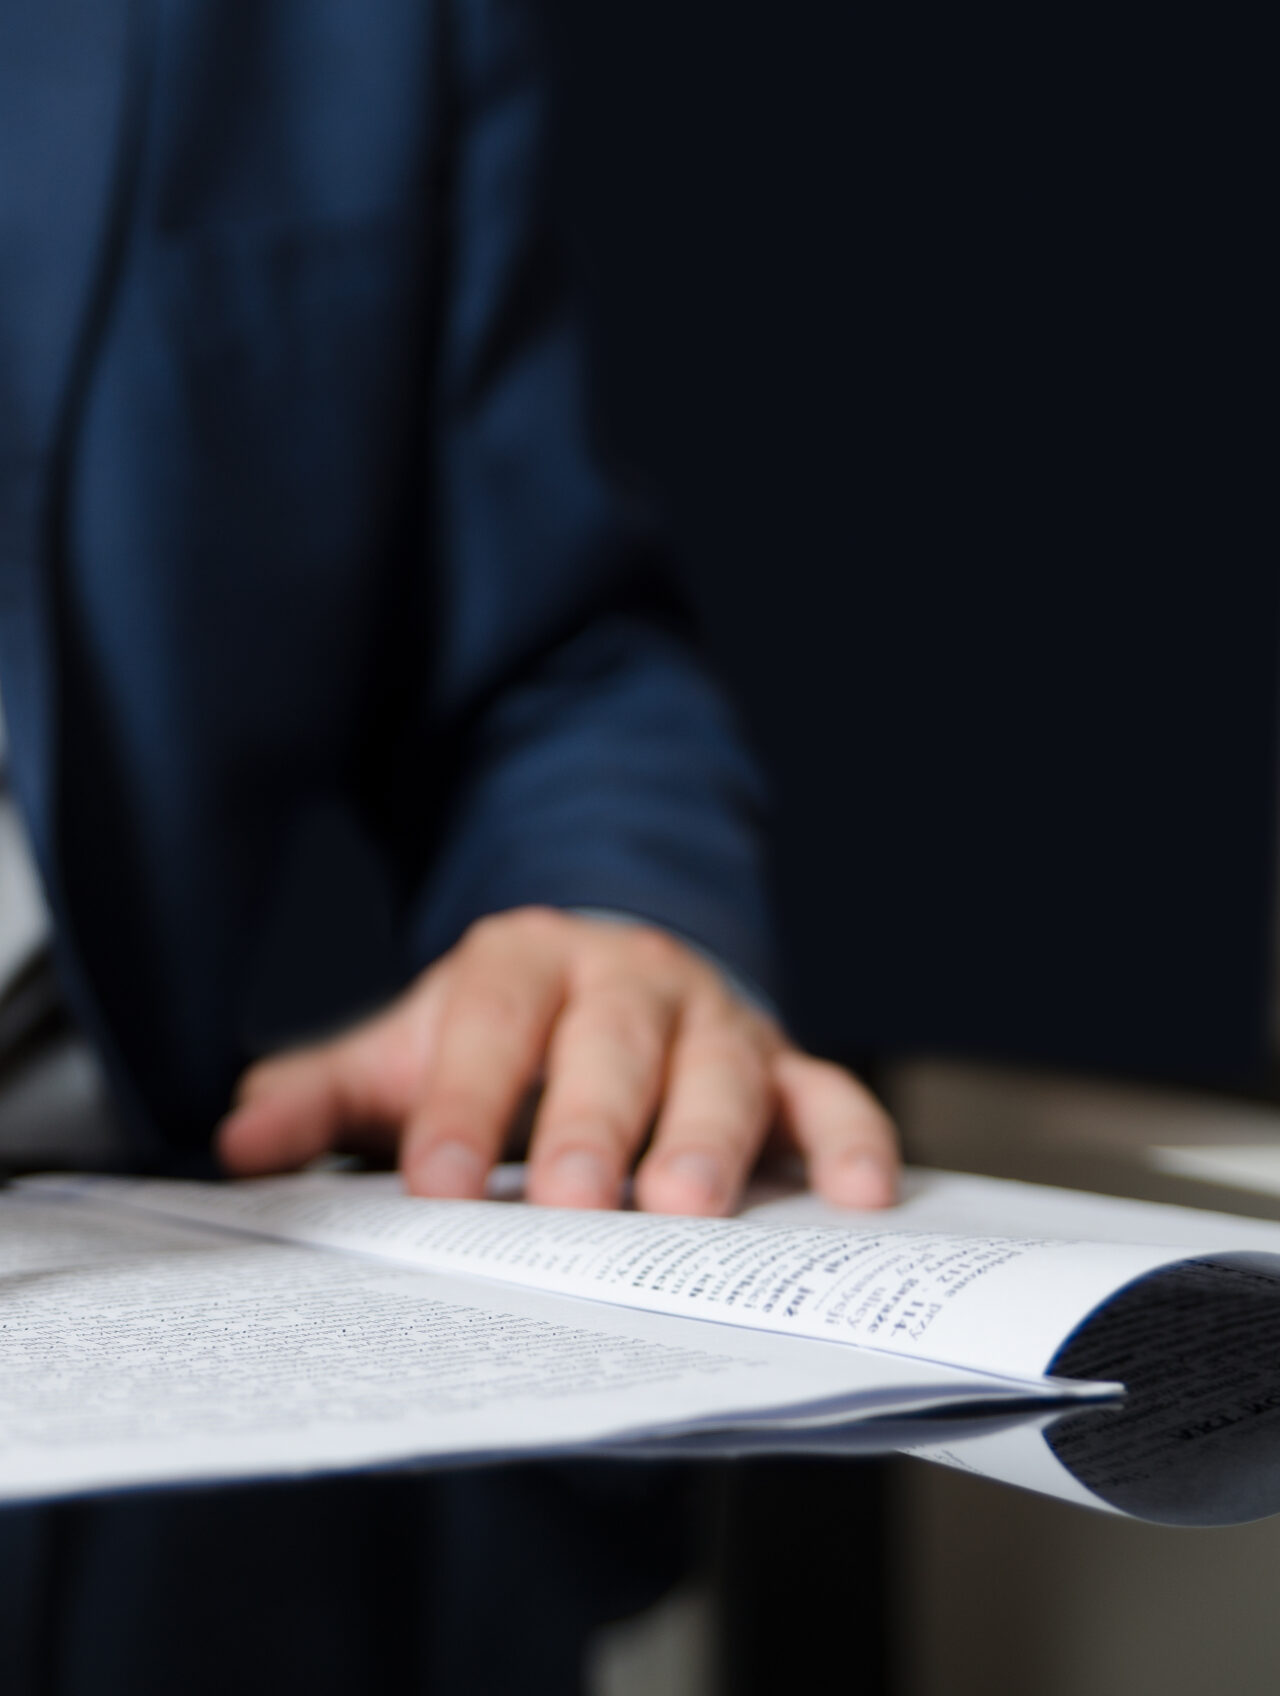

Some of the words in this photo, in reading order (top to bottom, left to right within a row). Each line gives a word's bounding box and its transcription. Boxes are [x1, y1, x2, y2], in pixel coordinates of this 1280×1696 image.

[847, 1287, 887, 1330] ulicy
[868, 1278, 919, 1333] garaże
[909, 1303, 942, 1340] przy
